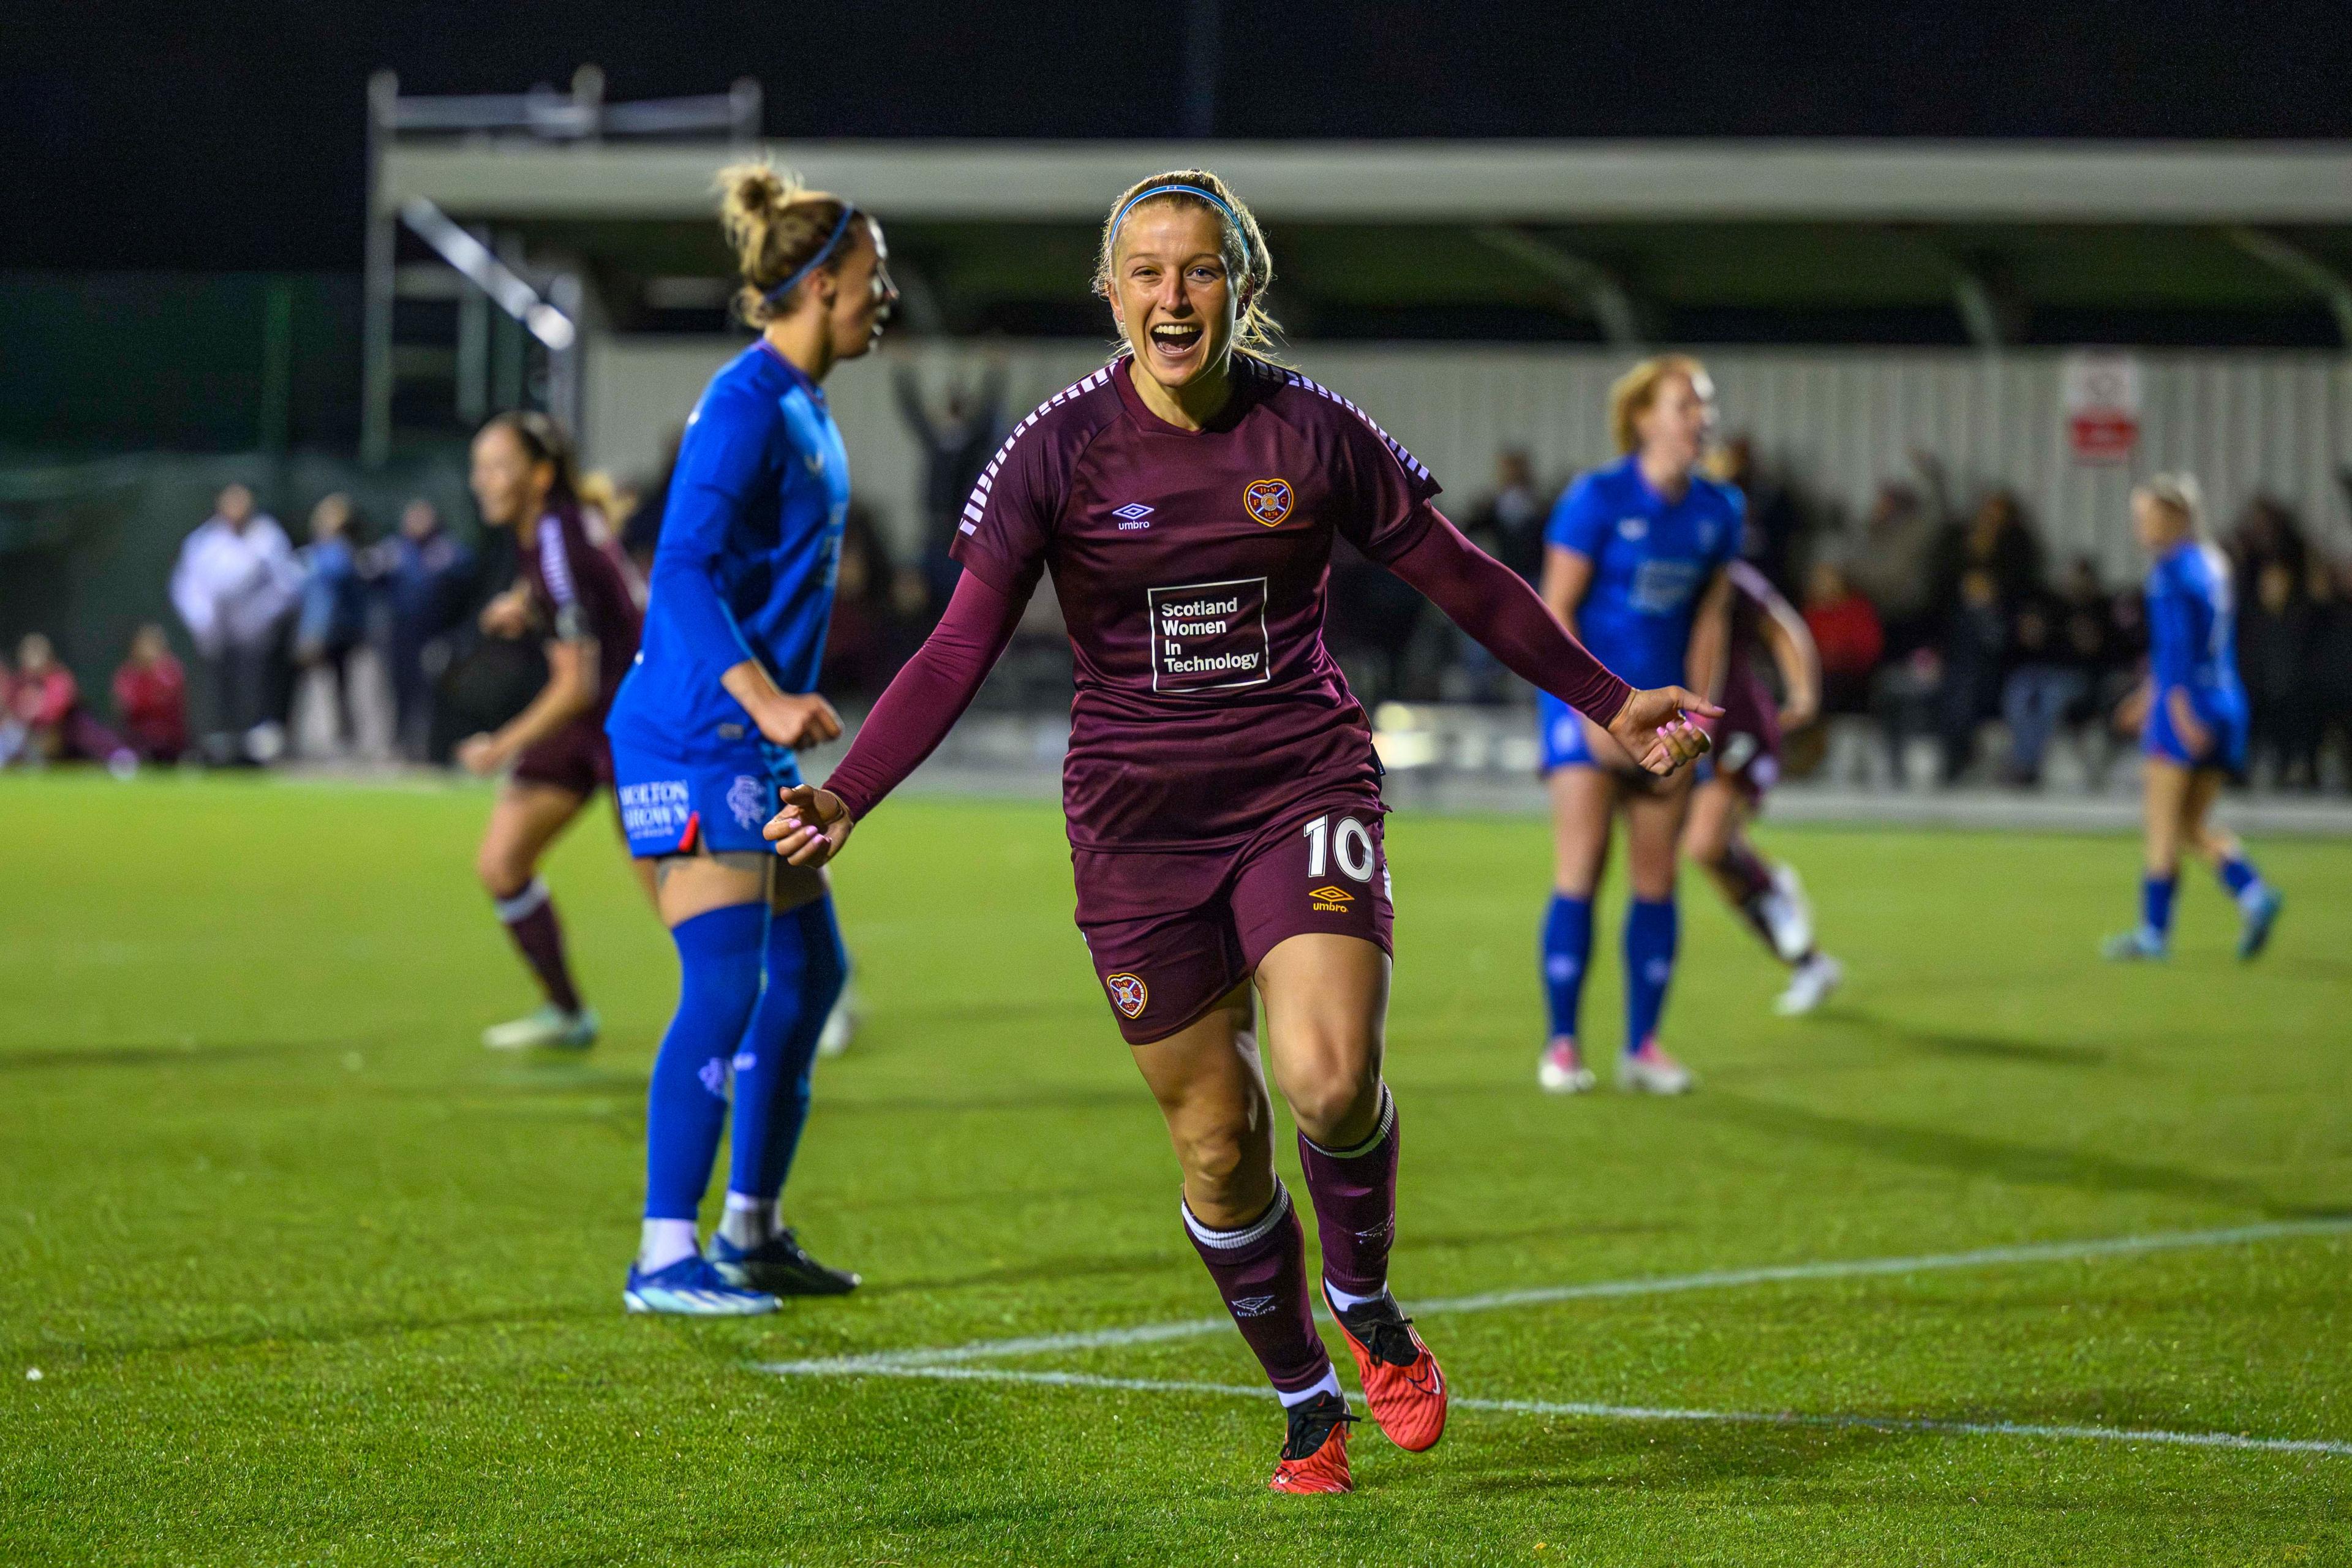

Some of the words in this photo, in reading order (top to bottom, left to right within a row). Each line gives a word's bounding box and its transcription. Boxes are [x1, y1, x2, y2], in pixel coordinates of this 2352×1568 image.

[1118, 520, 1150, 530] umbro
[1161, 597, 1238, 617] Scotland
[1161, 620, 1227, 636] Women
[1164, 639, 1182, 655] In
[1164, 652, 1259, 673] Technology
[1303, 815, 1374, 883] 10
[1313, 902, 1348, 913] umbro
